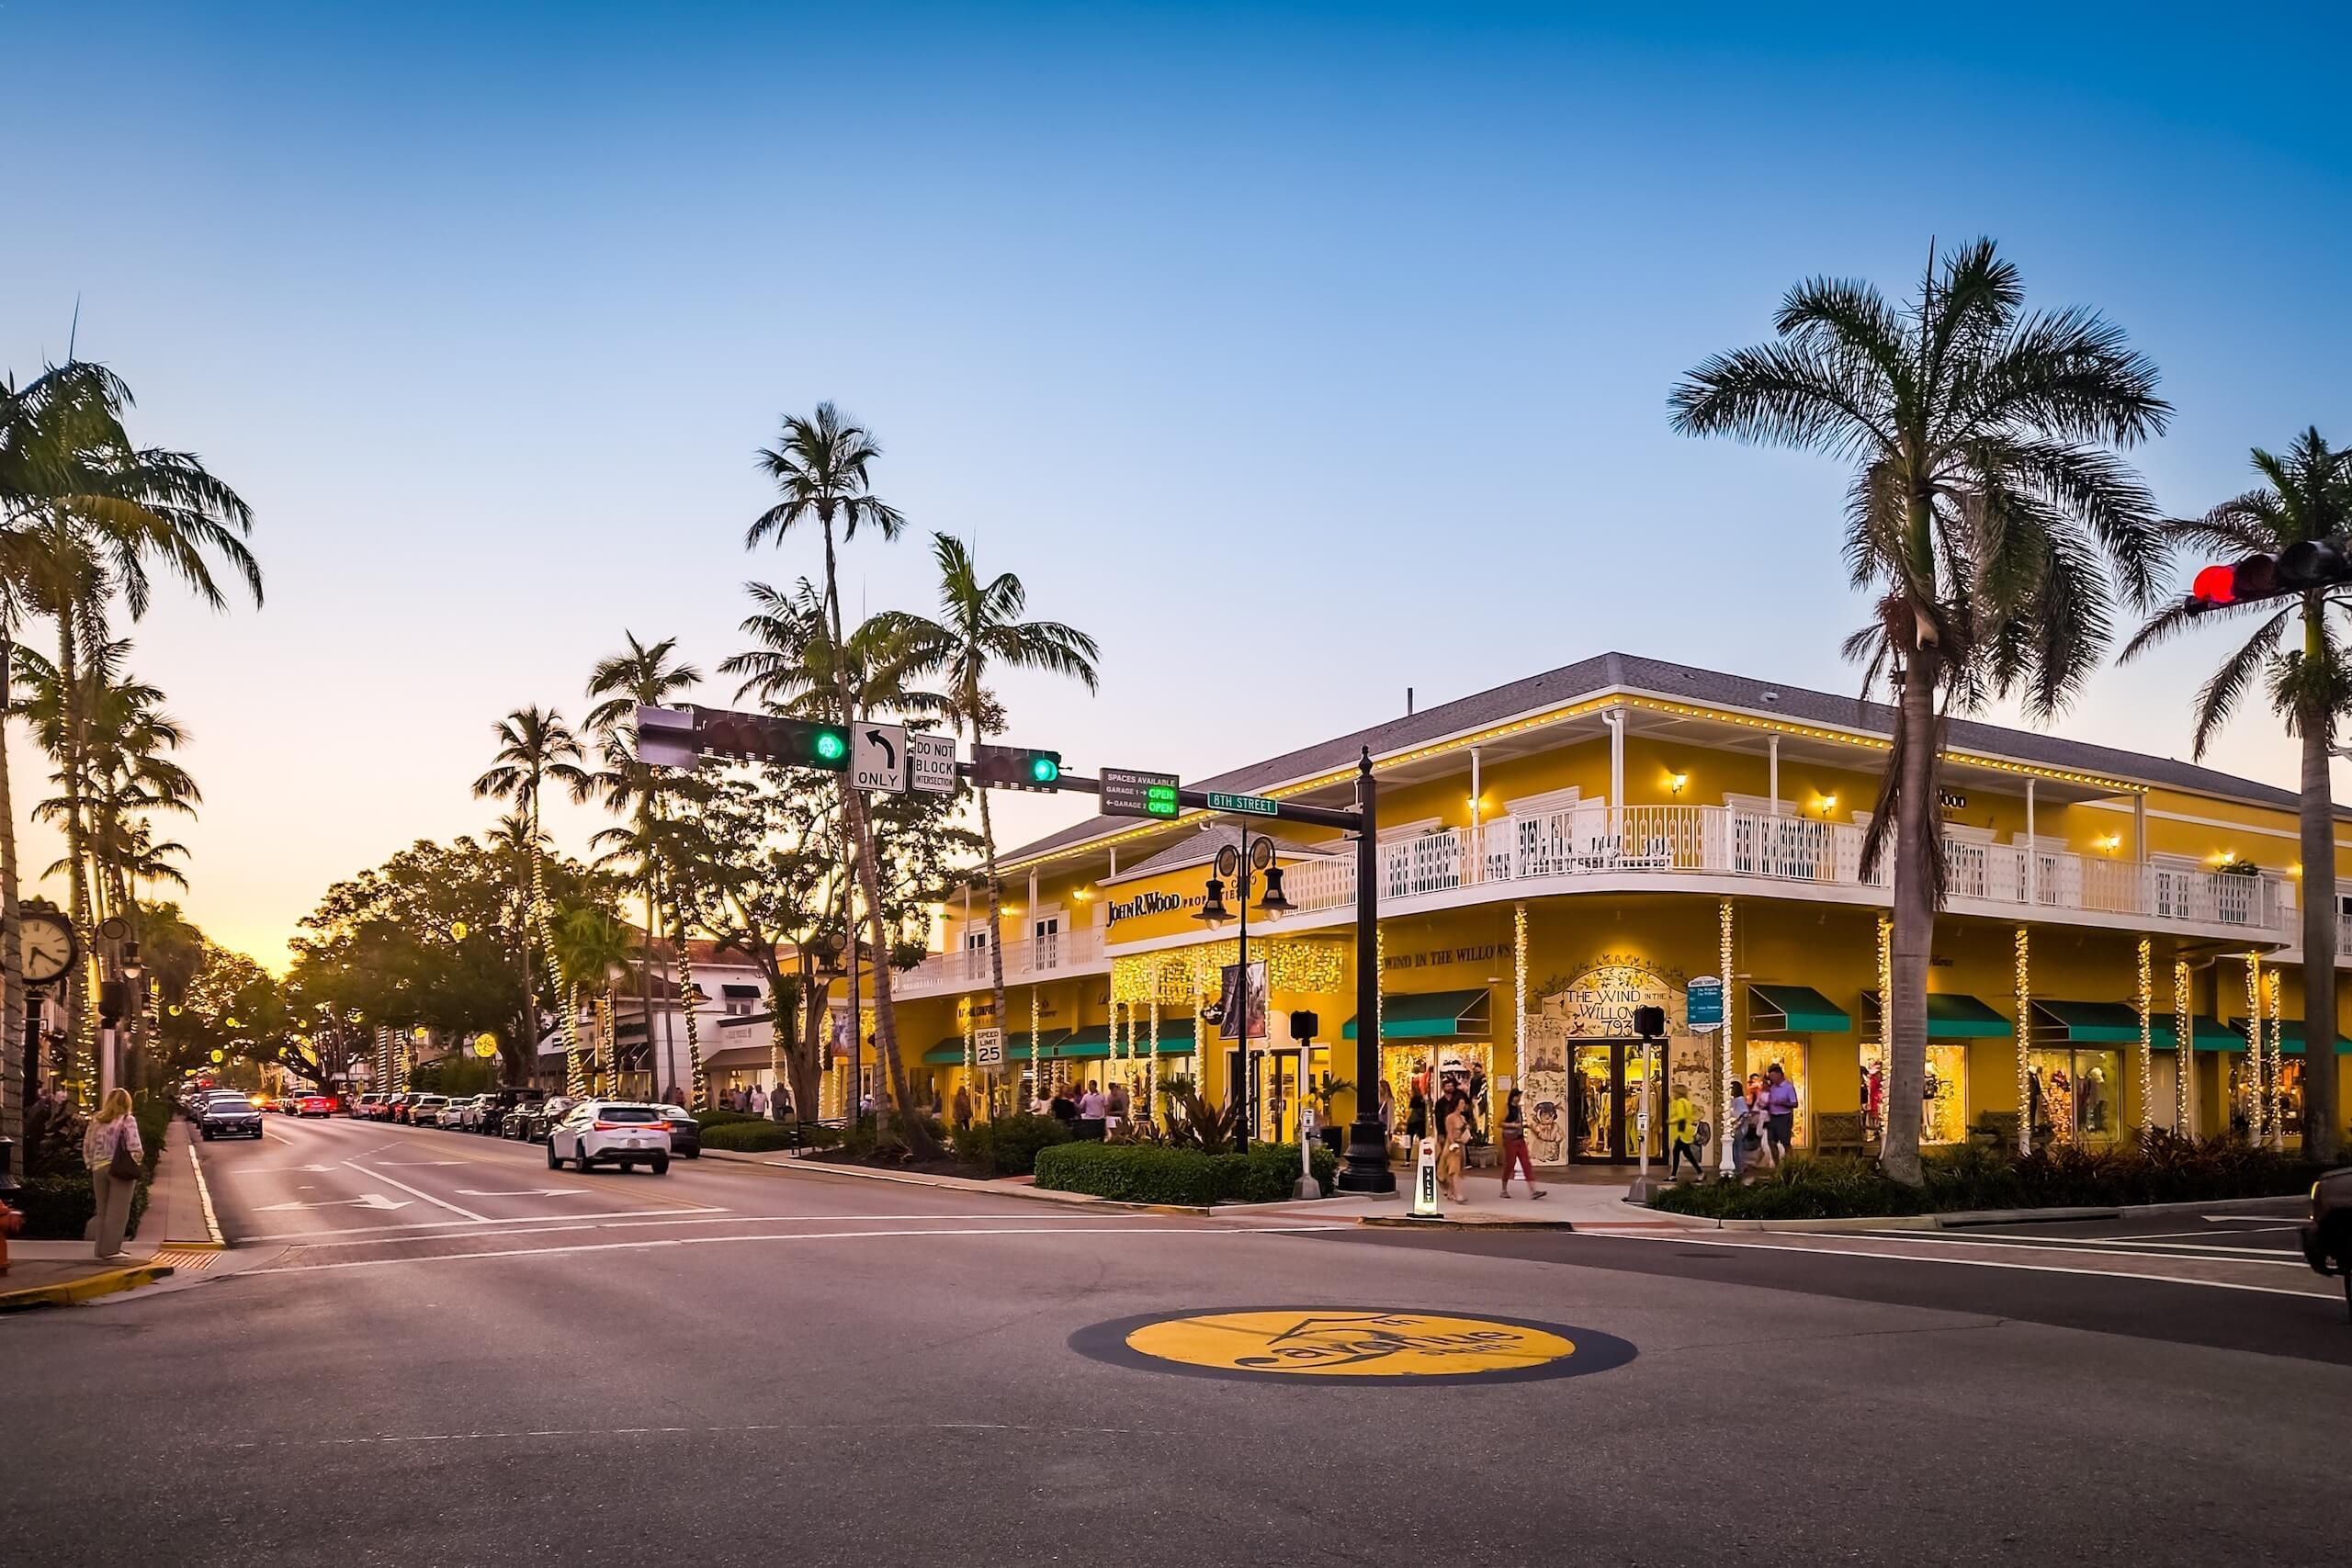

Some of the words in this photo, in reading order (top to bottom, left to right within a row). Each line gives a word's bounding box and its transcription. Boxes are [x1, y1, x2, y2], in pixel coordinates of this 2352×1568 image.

[917, 741, 931, 755] DO
[934, 744, 954, 758] NOT
[916, 760, 954, 775] BLOCK
[858, 772, 898, 787] ONLY
[915, 775, 953, 787] INTERSECTION
[1107, 773, 1136, 784] SPACES
[1137, 776, 1175, 787] AVAILABLE
[1106, 785, 1135, 795] GARAGE
[1148, 788, 1174, 800] OPEN
[1114, 800, 1141, 809] GARAGE
[1148, 801, 1174, 813] OPEN
[1214, 795, 1232, 807] 8TH
[1237, 797, 1272, 811] STREET
[1384, 954, 1412, 970] WIND
[1415, 952, 1427, 967] IN
[1430, 950, 1453, 965] THE
[1456, 943, 1512, 963] WILLOWS
[1565, 990, 1593, 1003] THE
[1597, 990, 1640, 1003] WIND
[977, 1031, 999, 1039] SPEED
[1601, 1020, 1633, 1037] 793
[978, 1047, 1001, 1062] 25
